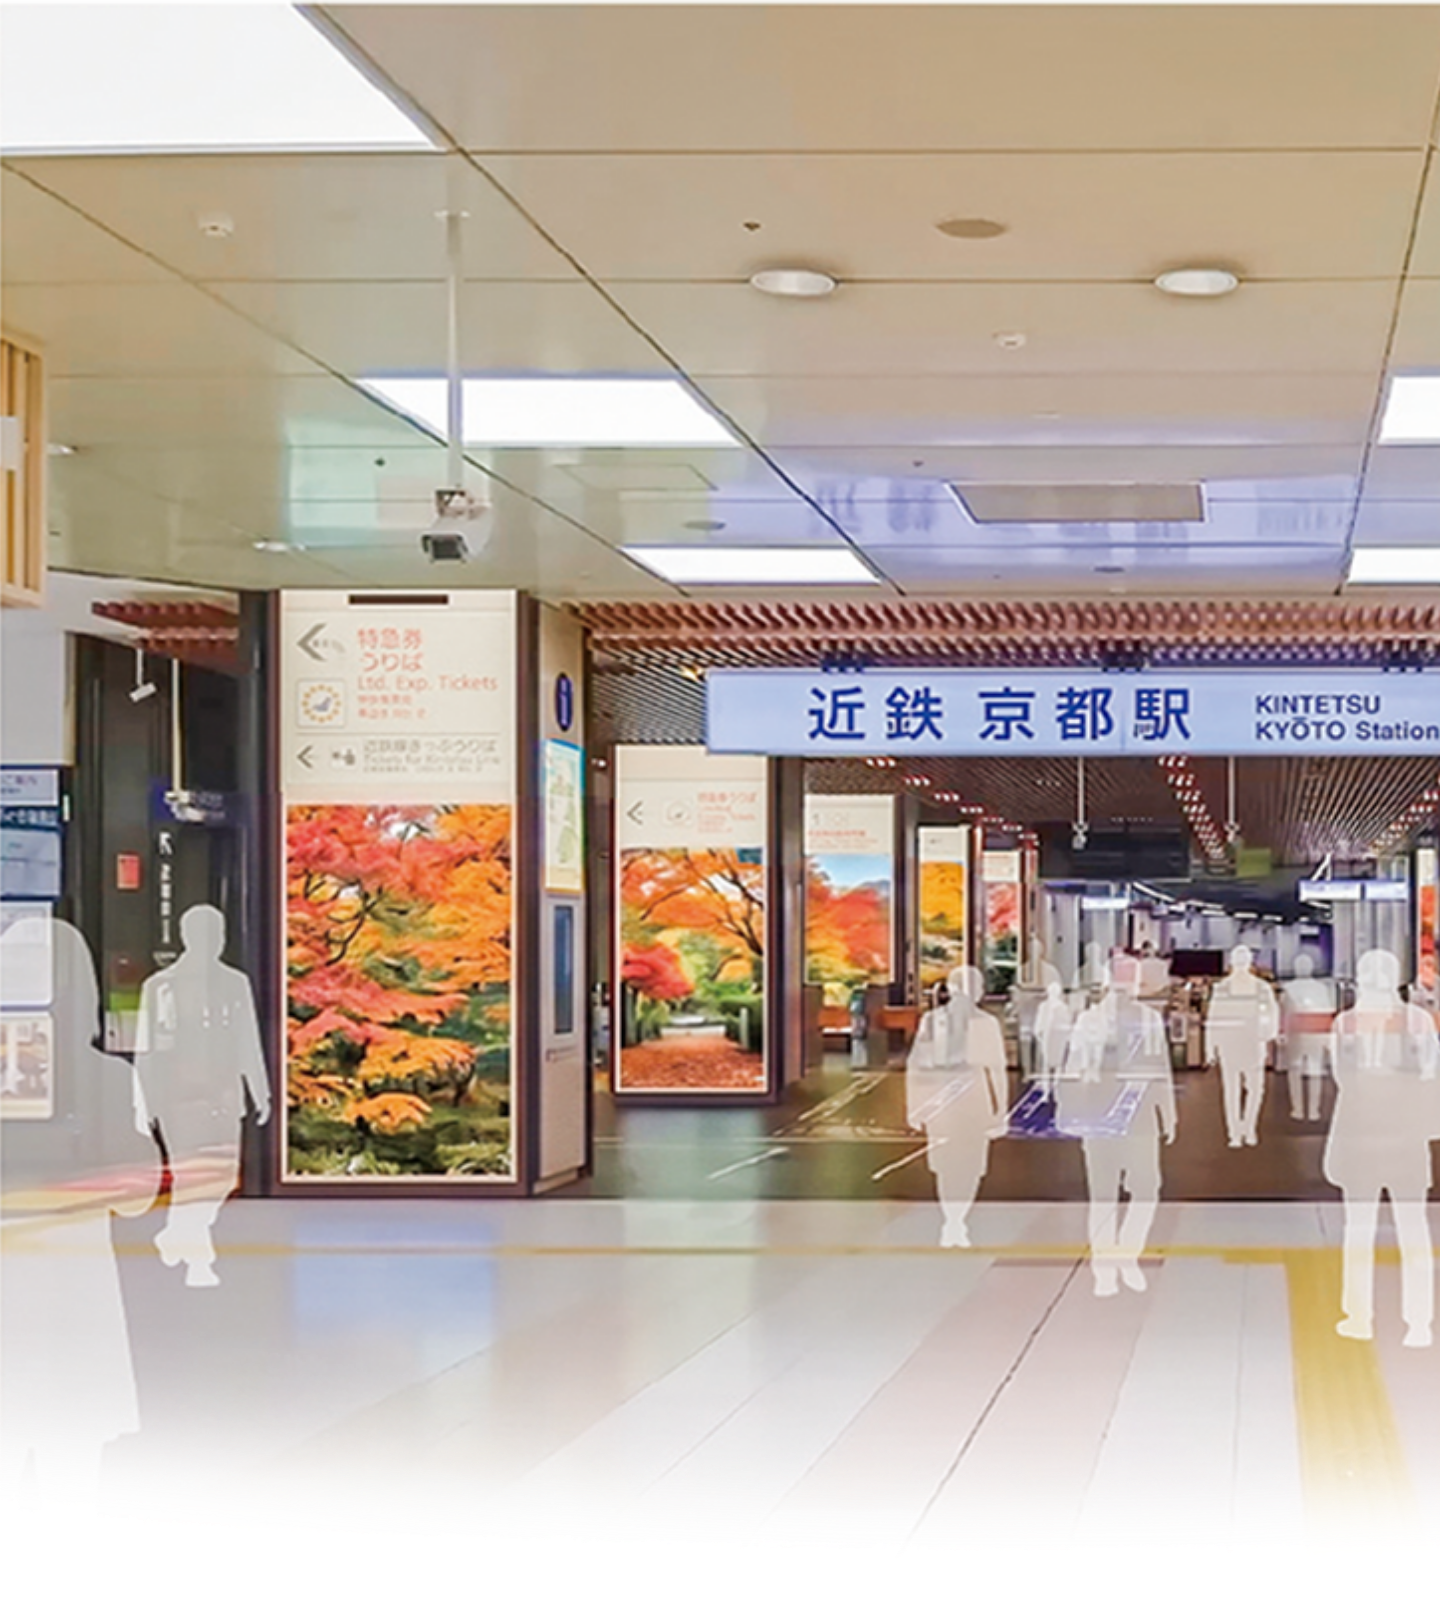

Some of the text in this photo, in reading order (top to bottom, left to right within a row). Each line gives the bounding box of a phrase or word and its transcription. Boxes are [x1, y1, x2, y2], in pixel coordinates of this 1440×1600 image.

[356, 626, 423, 649] 特急券
[358, 652, 425, 672] うりば
[438, 674, 499, 691] Tickets
[807, 685, 1192, 742] 近鉄 京都駅
[1255, 694, 1381, 715] KINTETSU
[1255, 716, 1440, 741] KYŌTO Station
